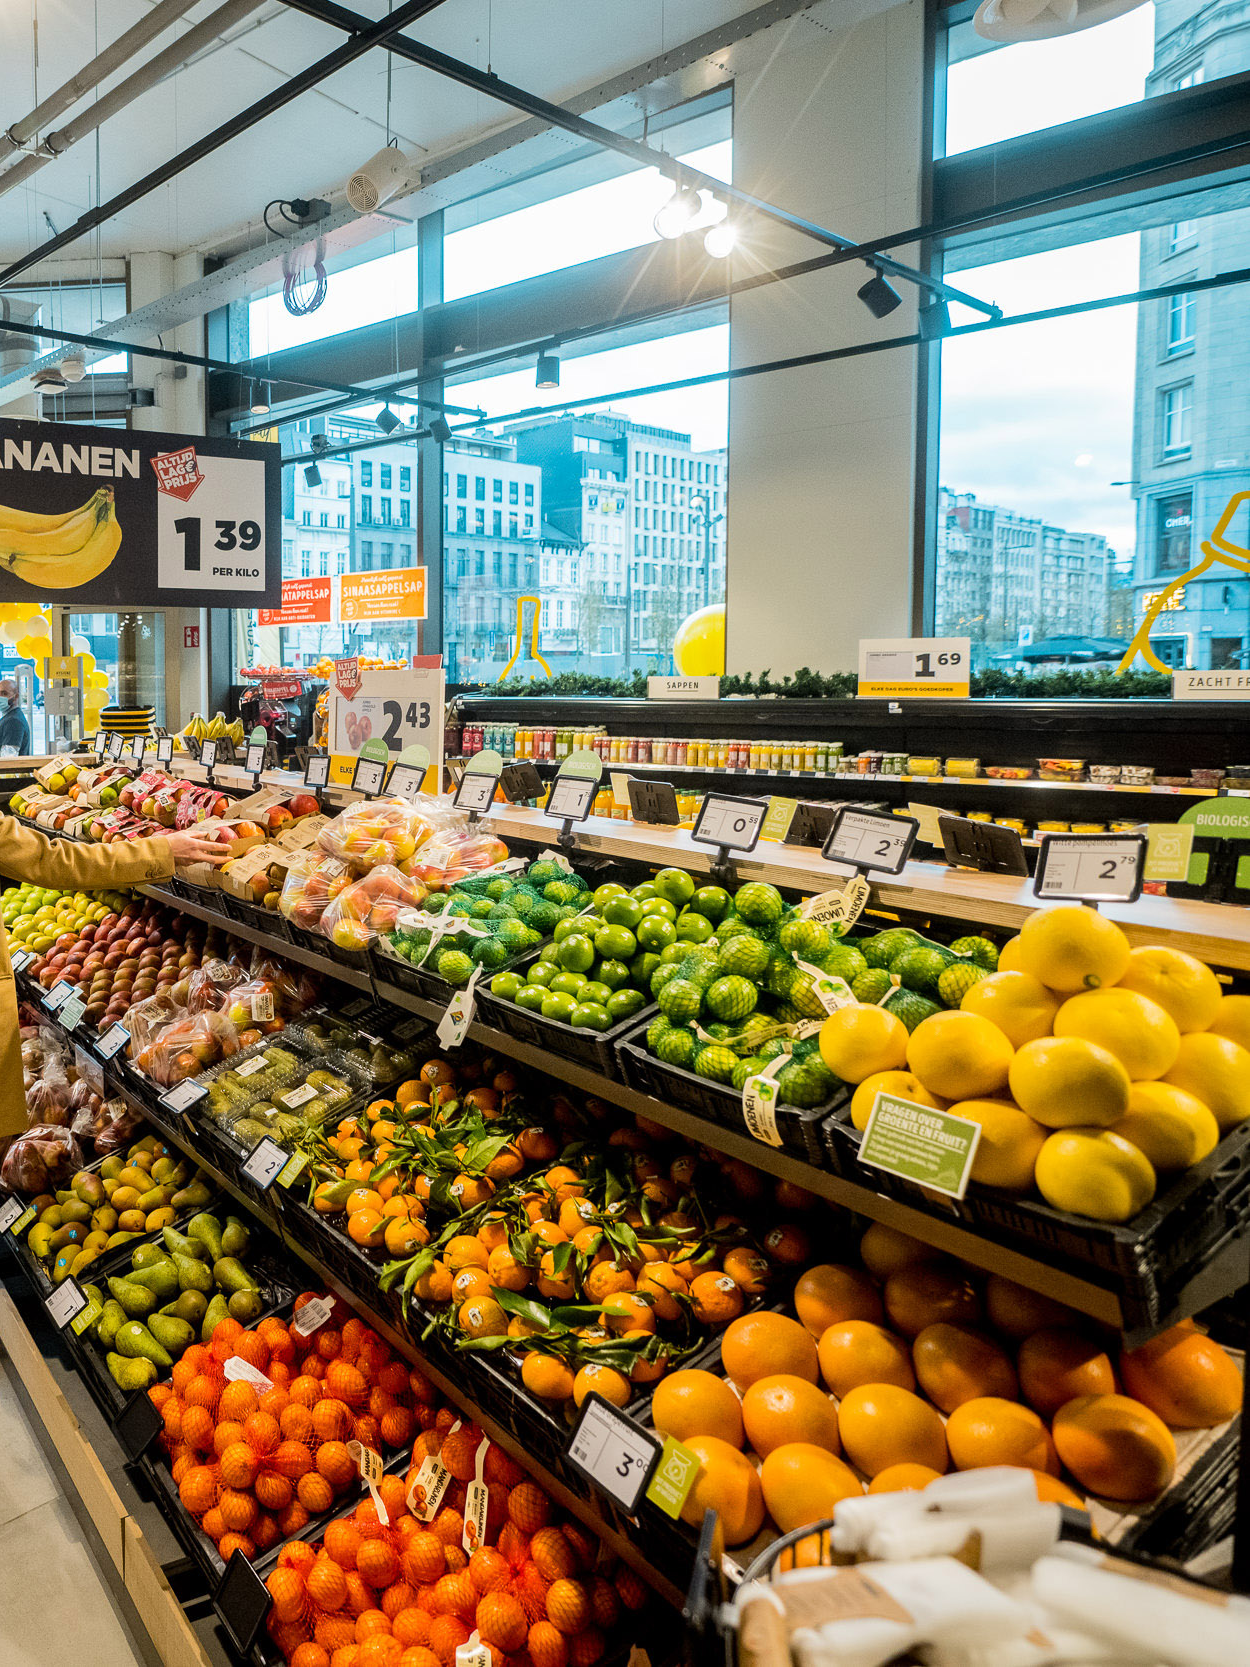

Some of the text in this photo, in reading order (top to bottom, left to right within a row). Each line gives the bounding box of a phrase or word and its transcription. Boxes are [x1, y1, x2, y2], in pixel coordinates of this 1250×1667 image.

[158, 452, 193, 470] ALTIJD
[164, 472, 197, 490] PRIJS
[174, 517, 262, 572] 1 39
[212, 567, 260, 578] PER KILO
[343, 581, 423, 598] SINAASAPPELSAP
[337, 661, 357, 671] ALTIJD
[915, 653, 961, 677] 1 69
[339, 679, 357, 688] PRIJS
[666, 681, 699, 689] SAPPEN
[1188, 677, 1232, 687] ZACHT
[382, 700, 431, 751] 2 43
[340, 766, 353, 775] ELKE
[371, 774, 378, 784] 3
[406, 782, 414, 791] 3
[478, 790, 486, 801] 3
[733, 818, 746, 833] 0
[874, 840, 891, 857] 2
[1099, 856, 1136, 879] 2 79
[845, 885, 868, 923] LIMOENEN
[881, 1101, 944, 1130] VRAGEN OVER
[877, 1111, 920, 1133] GROENTE
[920, 1124, 933, 1137] EN
[933, 1130, 968, 1150] FRUIT?
[616, 1452, 634, 1477] 3
